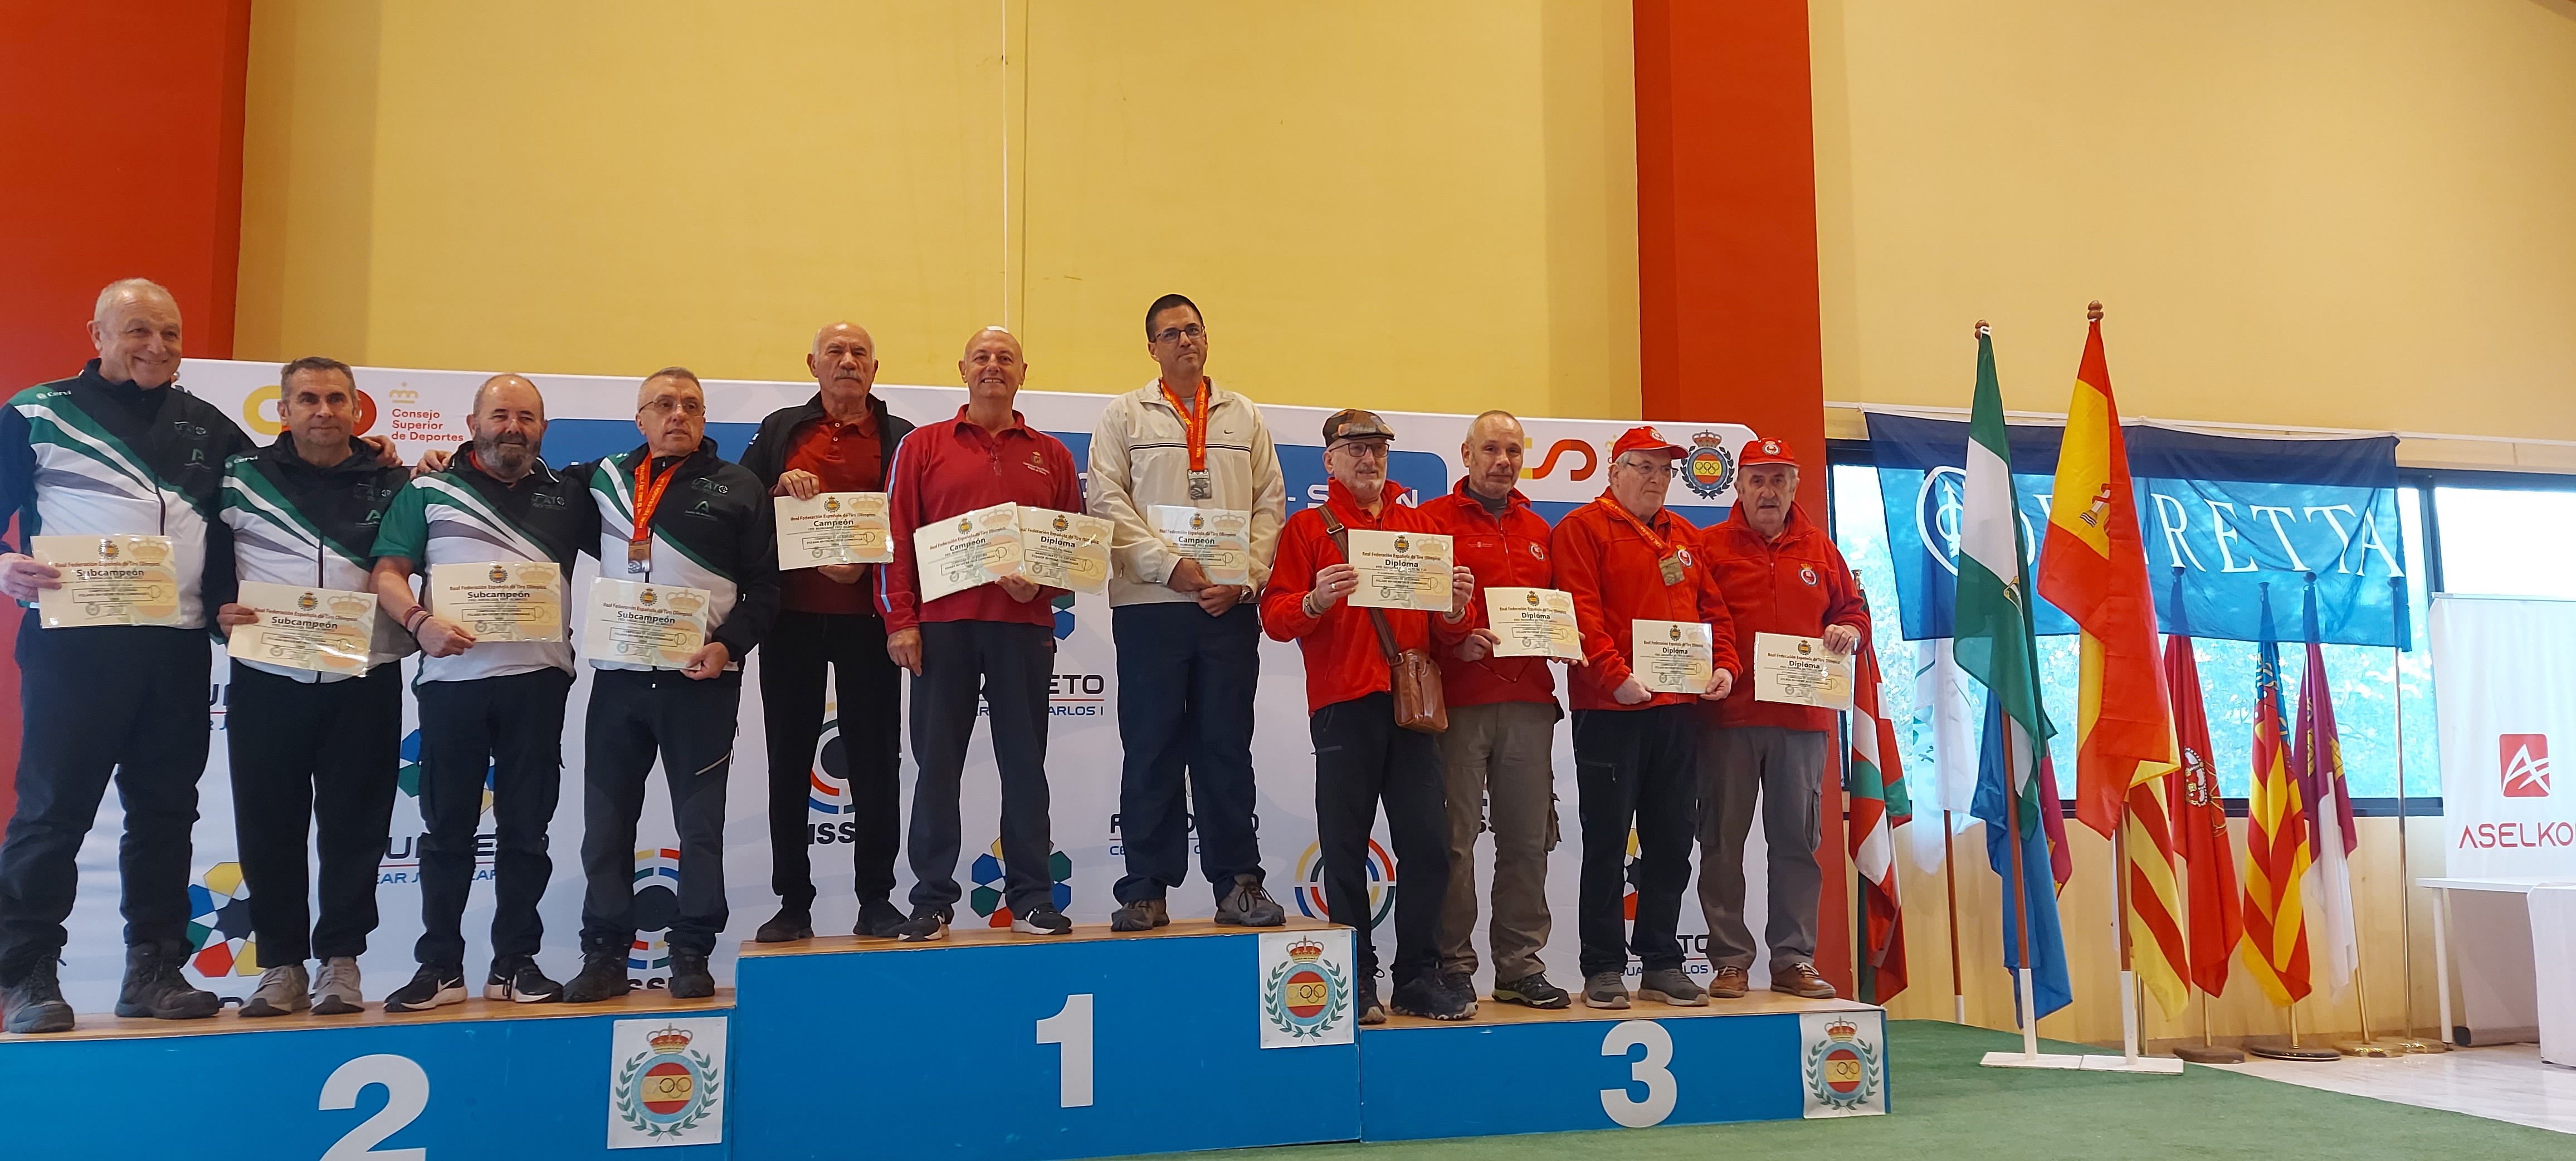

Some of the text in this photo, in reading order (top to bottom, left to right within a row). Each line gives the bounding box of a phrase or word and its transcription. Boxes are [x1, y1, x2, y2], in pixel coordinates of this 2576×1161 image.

[392, 408, 440, 420] Consejo
[392, 420, 443, 431] Superior
[392, 431, 464, 442] de Deportes
[1178, 536, 1214, 544] Campeón
[2145, 492, 2405, 577] RETTA
[949, 538, 985, 551] Campeón
[1041, 536, 1075, 548] Diploma
[76, 568, 144, 577] Subcampeón
[271, 616, 338, 629] Subcampeón
[617, 611, 675, 623] Subcampeón
[1048, 706, 1096, 715] ARLOS
[808, 822, 856, 845] ISS
[2459, 822, 2576, 848] ASELKO
[1036, 993, 1093, 1108] 1
[1600, 1020, 1677, 1128] 3
[318, 1053, 430, 1161] 2
